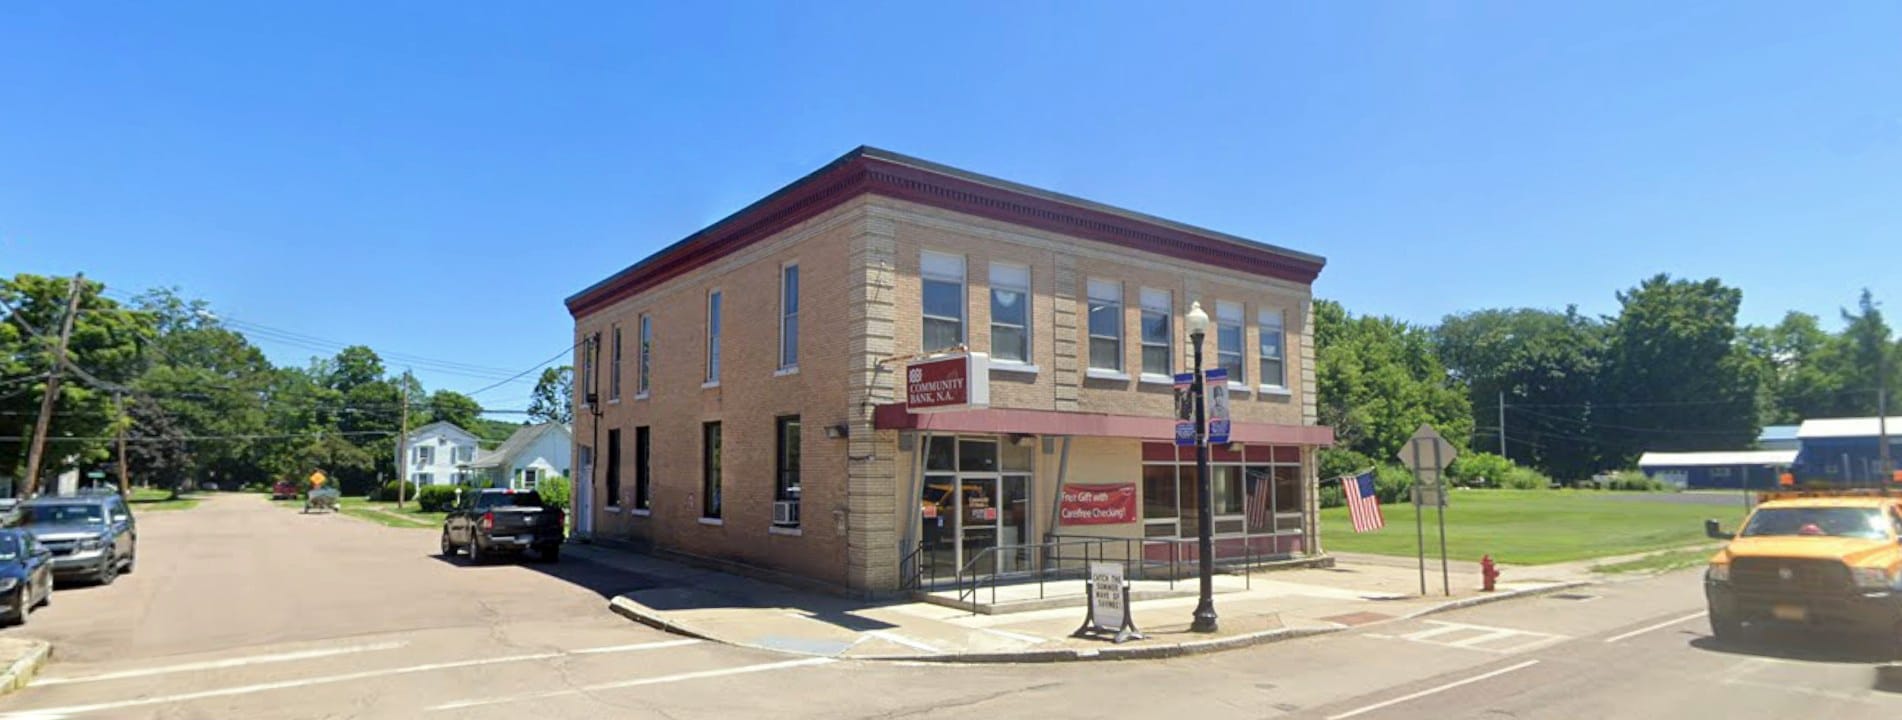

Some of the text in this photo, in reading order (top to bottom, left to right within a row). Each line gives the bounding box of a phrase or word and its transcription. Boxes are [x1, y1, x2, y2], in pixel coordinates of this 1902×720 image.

[910, 378, 964, 393] COMMUNITY
[910, 391, 954, 404] BANK, N.A.
[1062, 491, 1109, 502] Free Gift with
[1062, 506, 1126, 520] Carefree Checking!
[1111, 575, 1121, 584] THE
